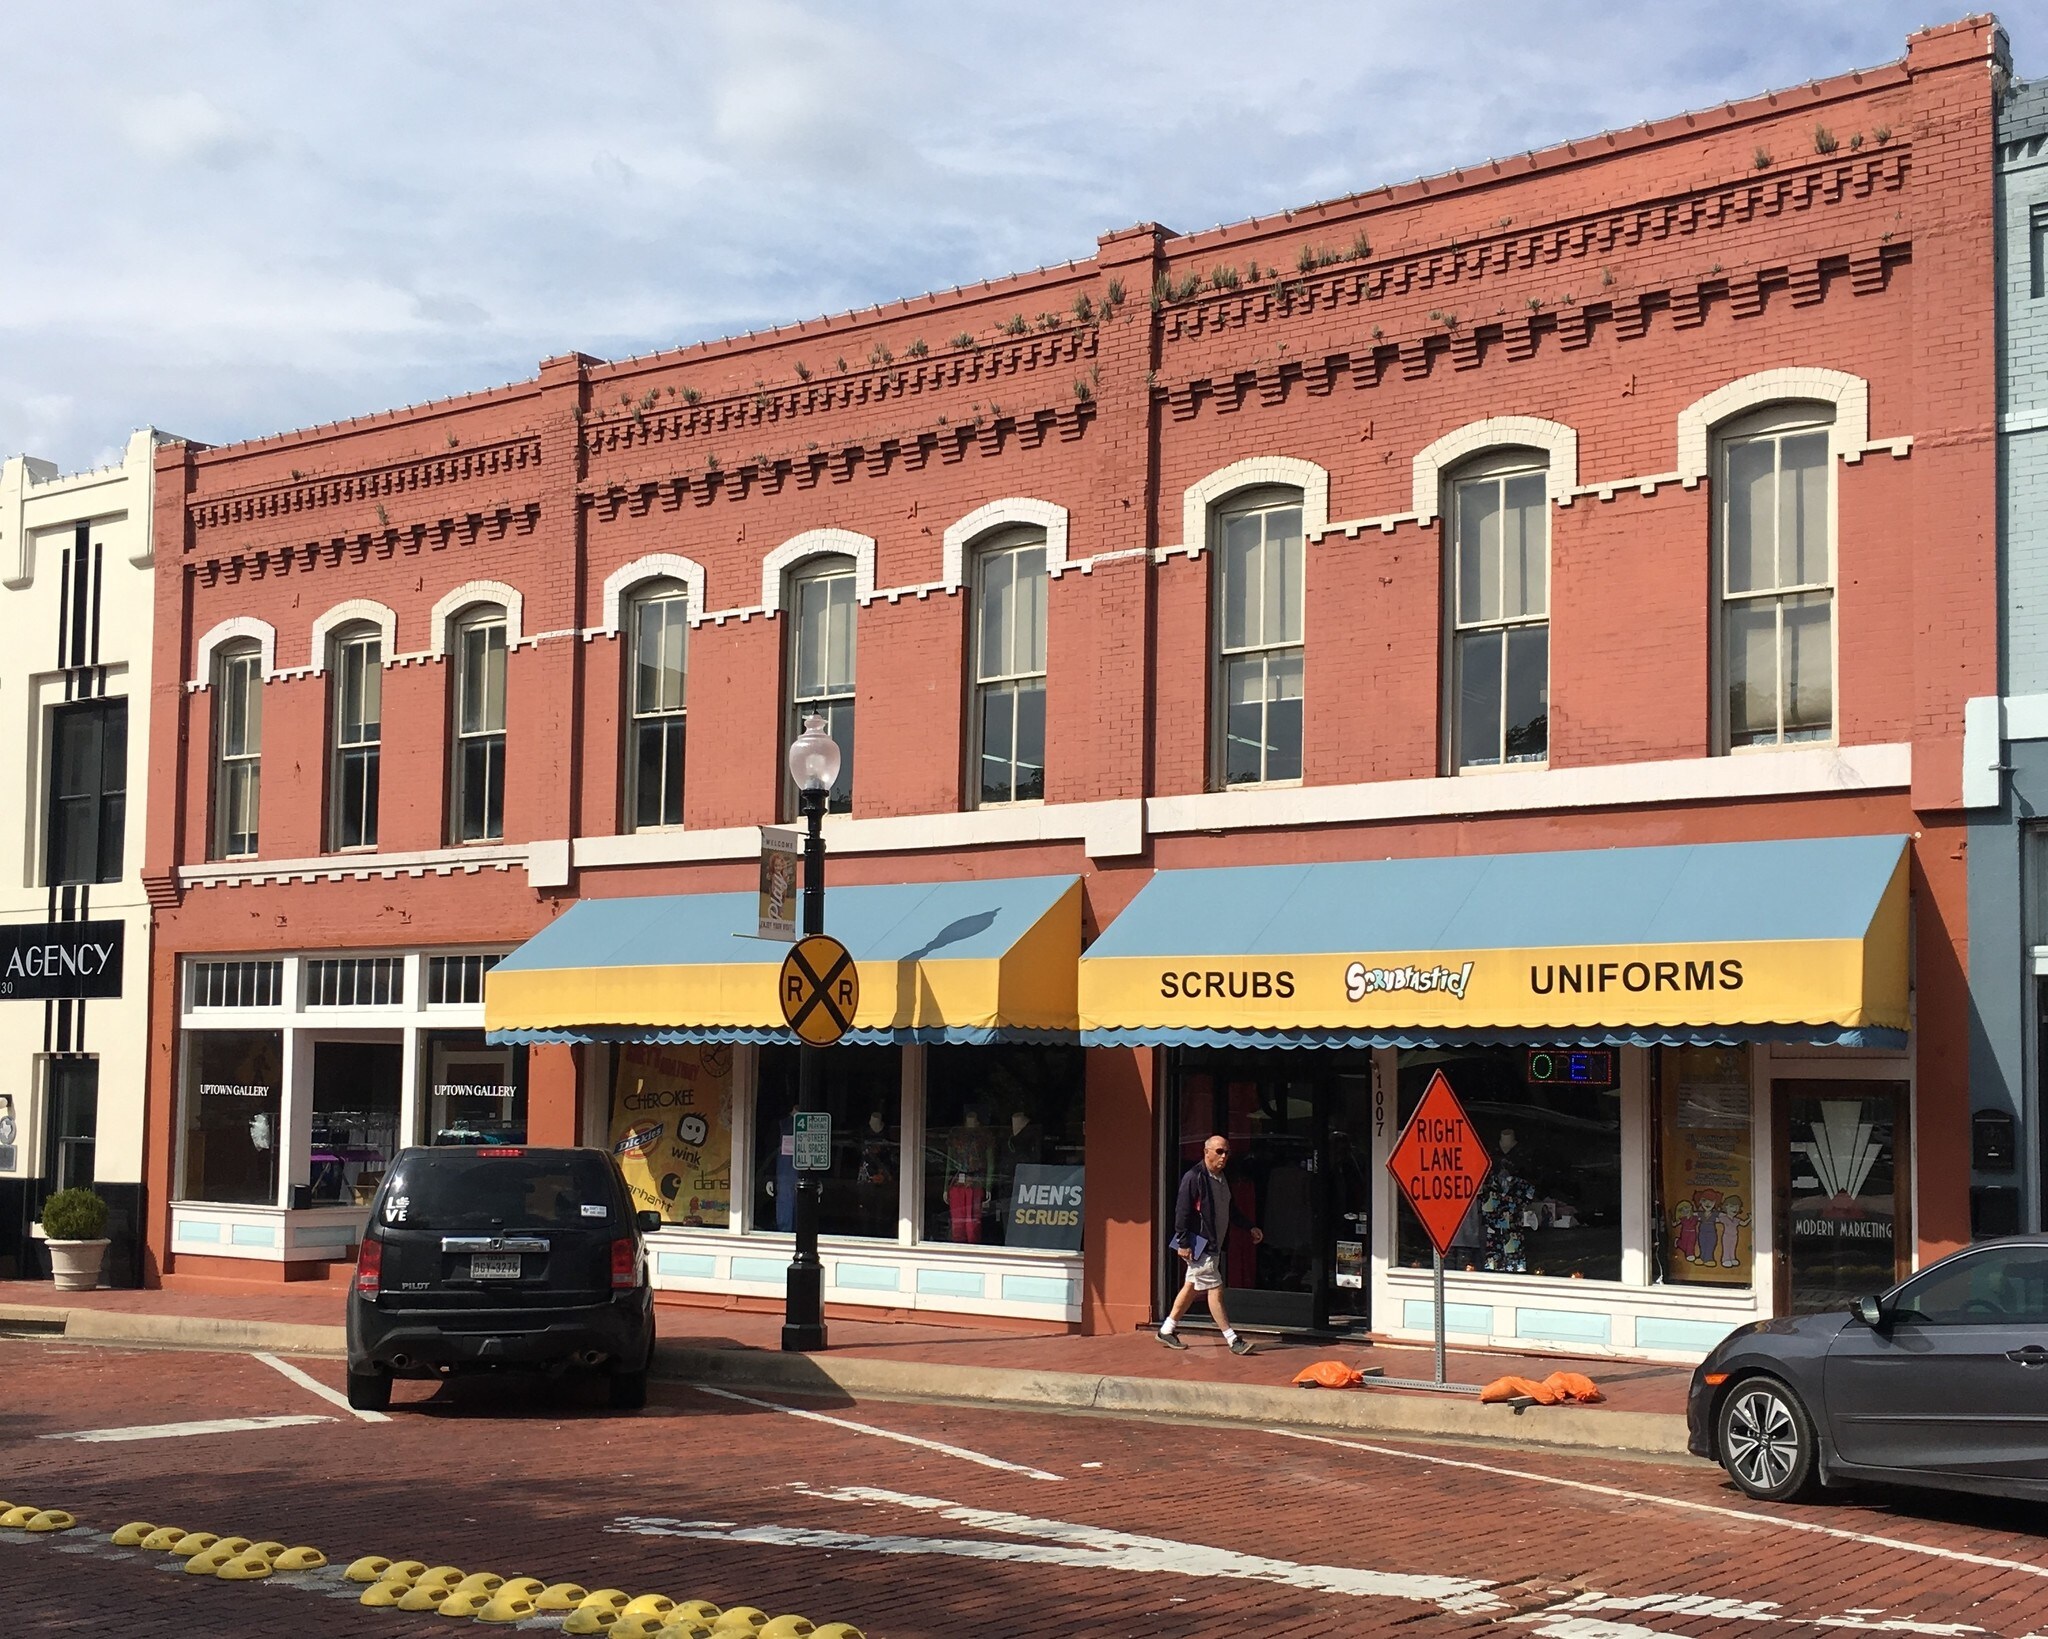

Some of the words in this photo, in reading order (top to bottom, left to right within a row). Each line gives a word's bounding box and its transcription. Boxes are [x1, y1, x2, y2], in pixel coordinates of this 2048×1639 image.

[766, 839, 793, 849] WELCOME
[5, 942, 114, 977] AGENCY
[787, 976, 803, 1002] R
[1160, 971, 1295, 999] SCRUBS
[1531, 959, 1744, 995] UNIFORMS
[838, 980, 853, 1006] R
[200, 1084, 233, 1096] UPTOWN
[233, 1085, 269, 1097] GALLERY
[434, 1084, 473, 1096] UPTOWN
[473, 1085, 517, 1098] GALLERY
[624, 1088, 695, 1111] CHEROKEE
[1375, 1074, 1384, 1137] 1007
[797, 1118, 806, 1129] 4
[1416, 1118, 1464, 1143] RIGHT
[807, 1133, 827, 1142] STREET
[672, 1146, 701, 1166] wink
[797, 1155, 808, 1165] ALL
[810, 1155, 827, 1165] TIMES
[1420, 1147, 1464, 1172] LANE
[627, 1183, 673, 1213] arhartt
[1017, 1184, 1083, 1206] MEN'S
[1410, 1175, 1474, 1201] CLOSED
[1014, 1208, 1079, 1226] SCRUBS
[1795, 1219, 1835, 1236] MODERN
[1840, 1221, 1893, 1239] MARKETING
[401, 1282, 431, 1290] PILOT
